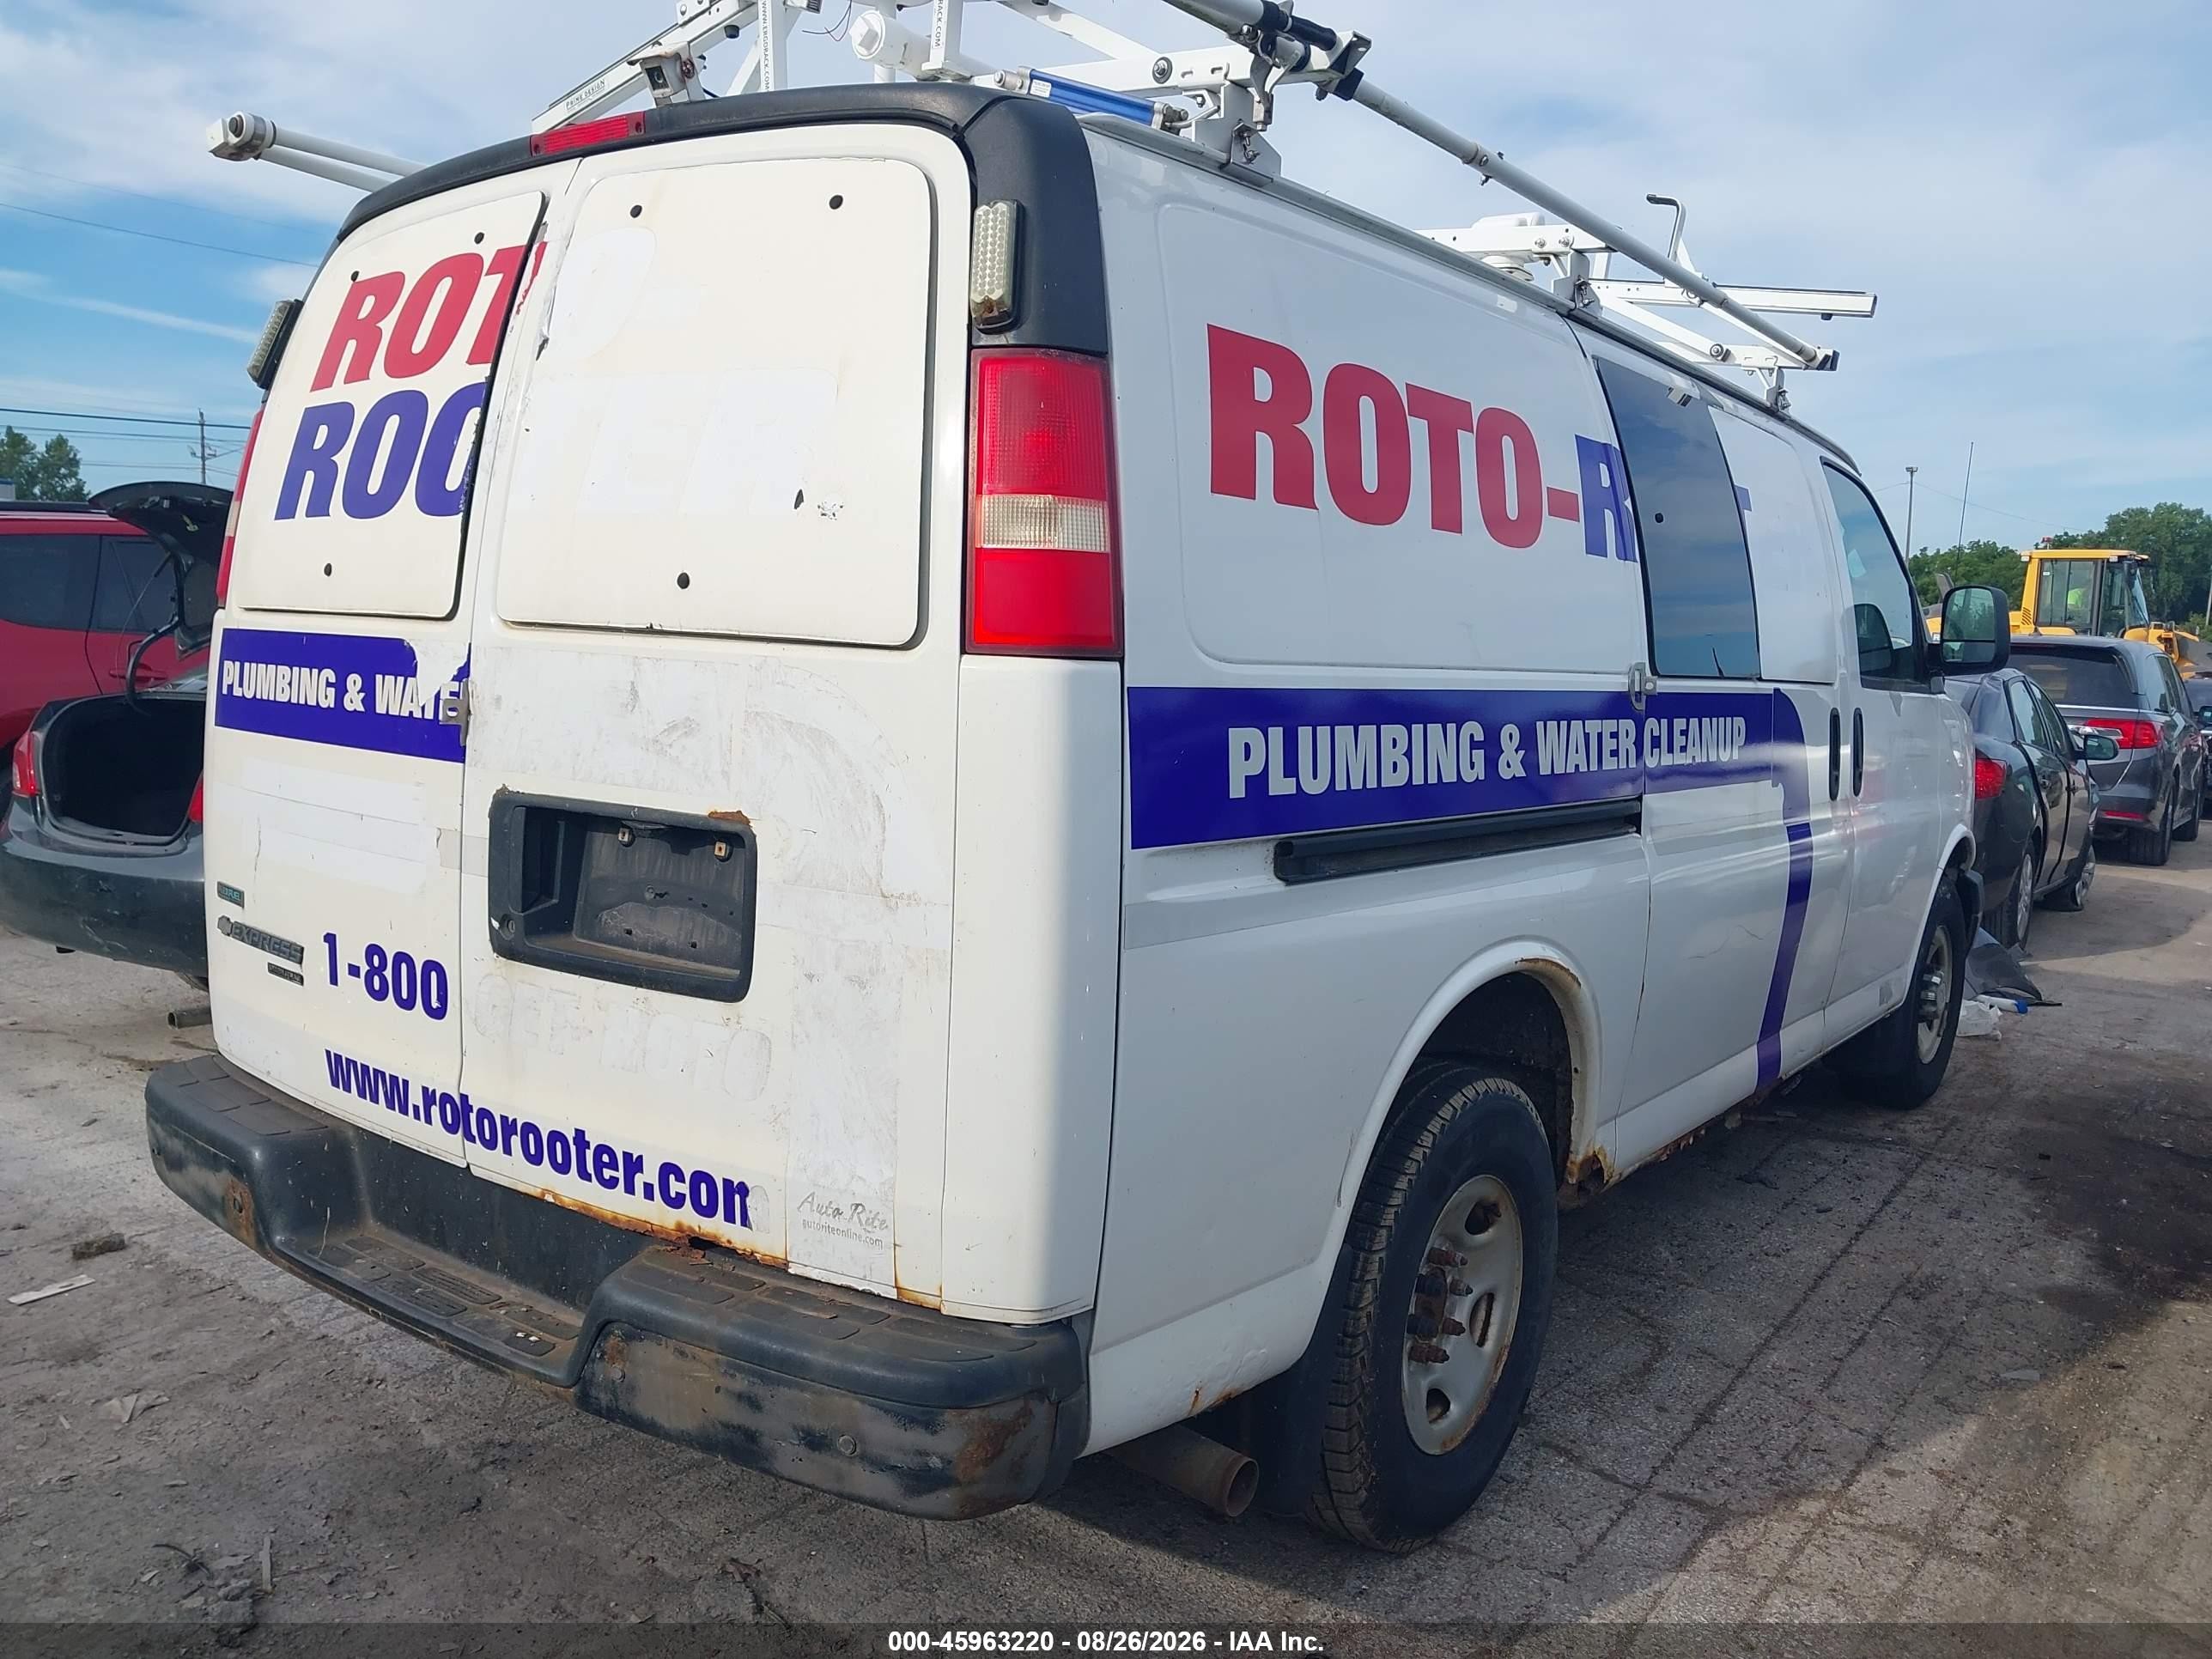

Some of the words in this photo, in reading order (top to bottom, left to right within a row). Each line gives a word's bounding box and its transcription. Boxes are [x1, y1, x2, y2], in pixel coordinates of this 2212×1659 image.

[222, 659, 336, 709] PLUMBING
[343, 675, 366, 713] &
[1228, 721, 1485, 799] PLUMBING
[1498, 724, 1526, 777] &
[1536, 719, 1637, 775] WATER
[1644, 716, 1747, 767] CLEANUP
[232, 921, 304, 964] EXPRESS
[323, 933, 449, 1020] 1-800
